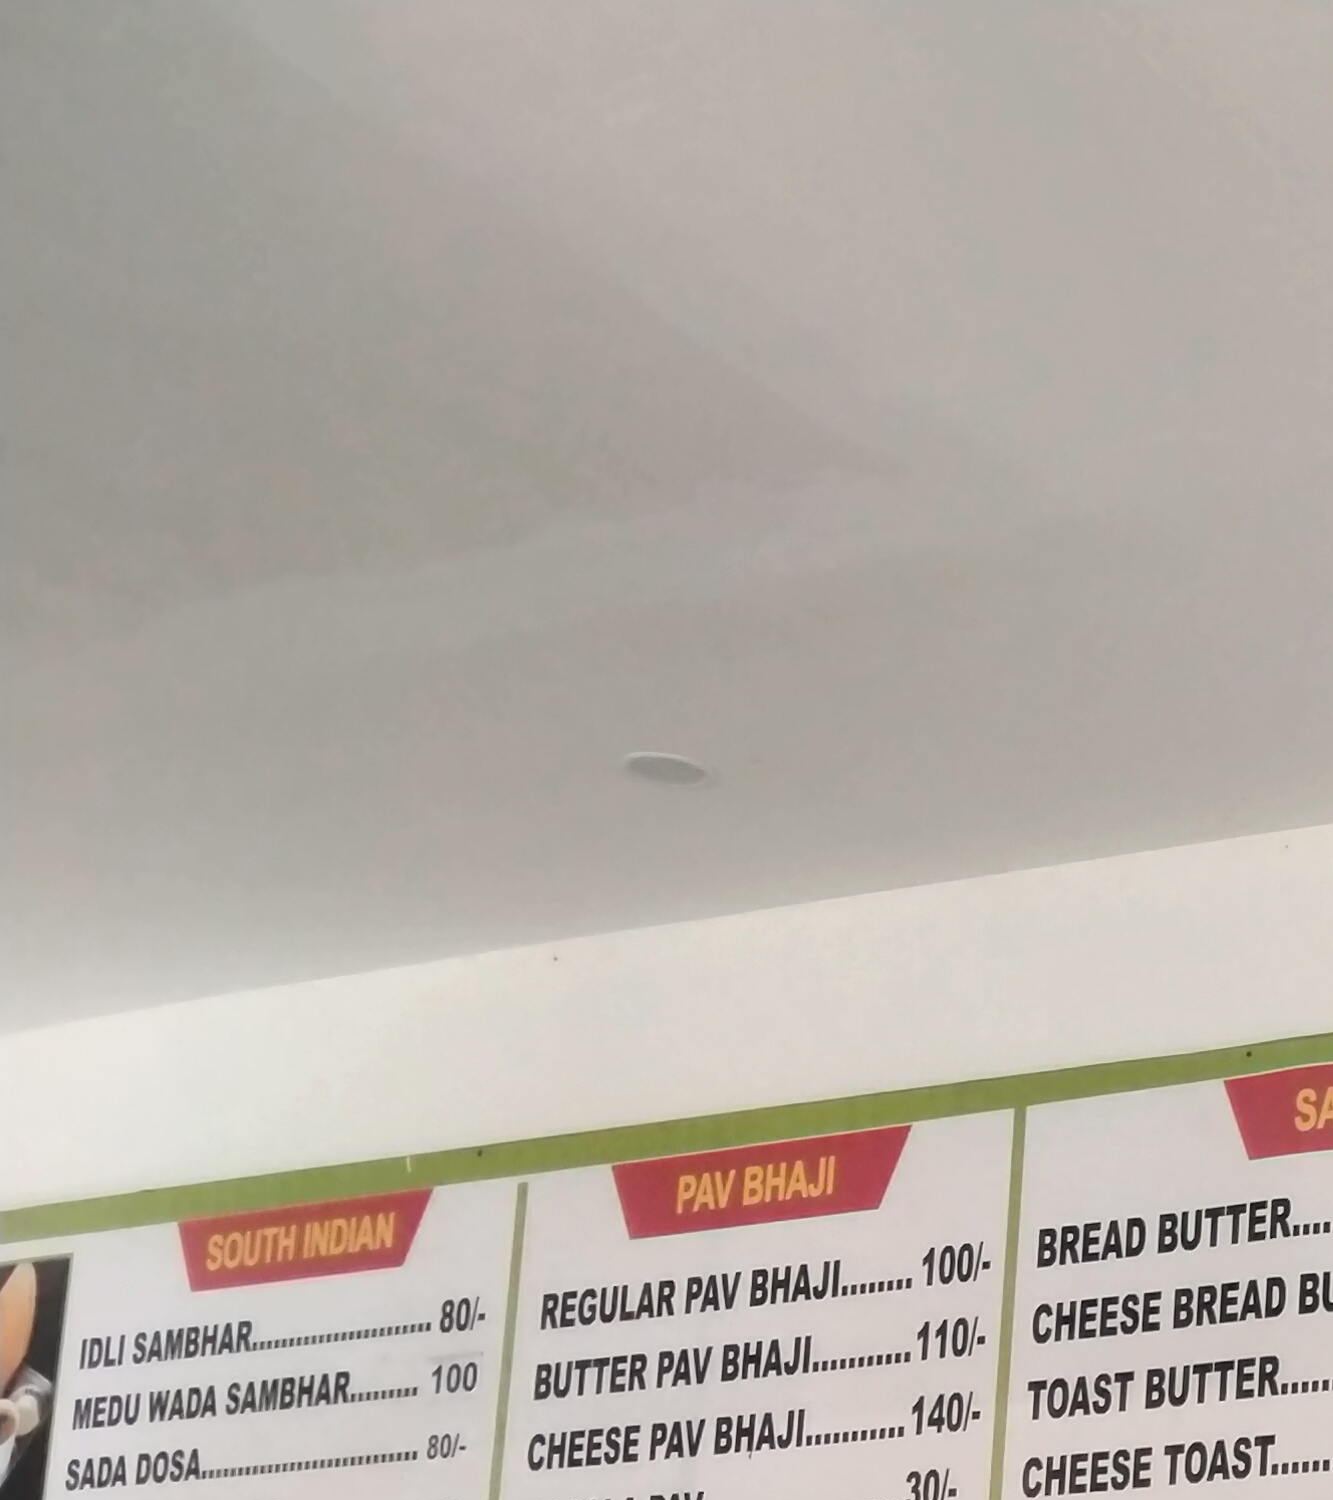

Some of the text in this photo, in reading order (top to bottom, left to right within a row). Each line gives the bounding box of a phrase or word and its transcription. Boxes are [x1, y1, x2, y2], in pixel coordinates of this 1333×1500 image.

[676, 1155, 836, 1214] PAV BHAJI
[205, 1212, 395, 1272] SOUTH INDIAN
[1036, 1217, 1147, 1269] BREAD
[540, 1279, 675, 1330] REGULAR
[684, 1271, 742, 1314] PAV
[922, 1241, 992, 1287] 100/-
[1032, 1292, 1162, 1344] CHEESE
[1172, 1276, 1287, 1329] BREAD
[79, 1336, 126, 1370] IDLI
[439, 1296, 486, 1334] 80/-
[533, 1353, 648, 1401] BUTTER
[656, 1345, 713, 1387] PAV
[916, 1316, 986, 1361] 110/-
[72, 1393, 141, 1430] MEDU
[149, 1385, 217, 1423] WADA
[431, 1361, 478, 1394] 100
[1027, 1371, 1135, 1421] TOAST
[65, 1455, 127, 1491] SADA
[426, 1434, 467, 1460] 80/-
[527, 1426, 641, 1472] CHEESE
[649, 1418, 706, 1461] PAV
[911, 1391, 981, 1436] 140/-
[1022, 1447, 1153, 1499] CHEESE
